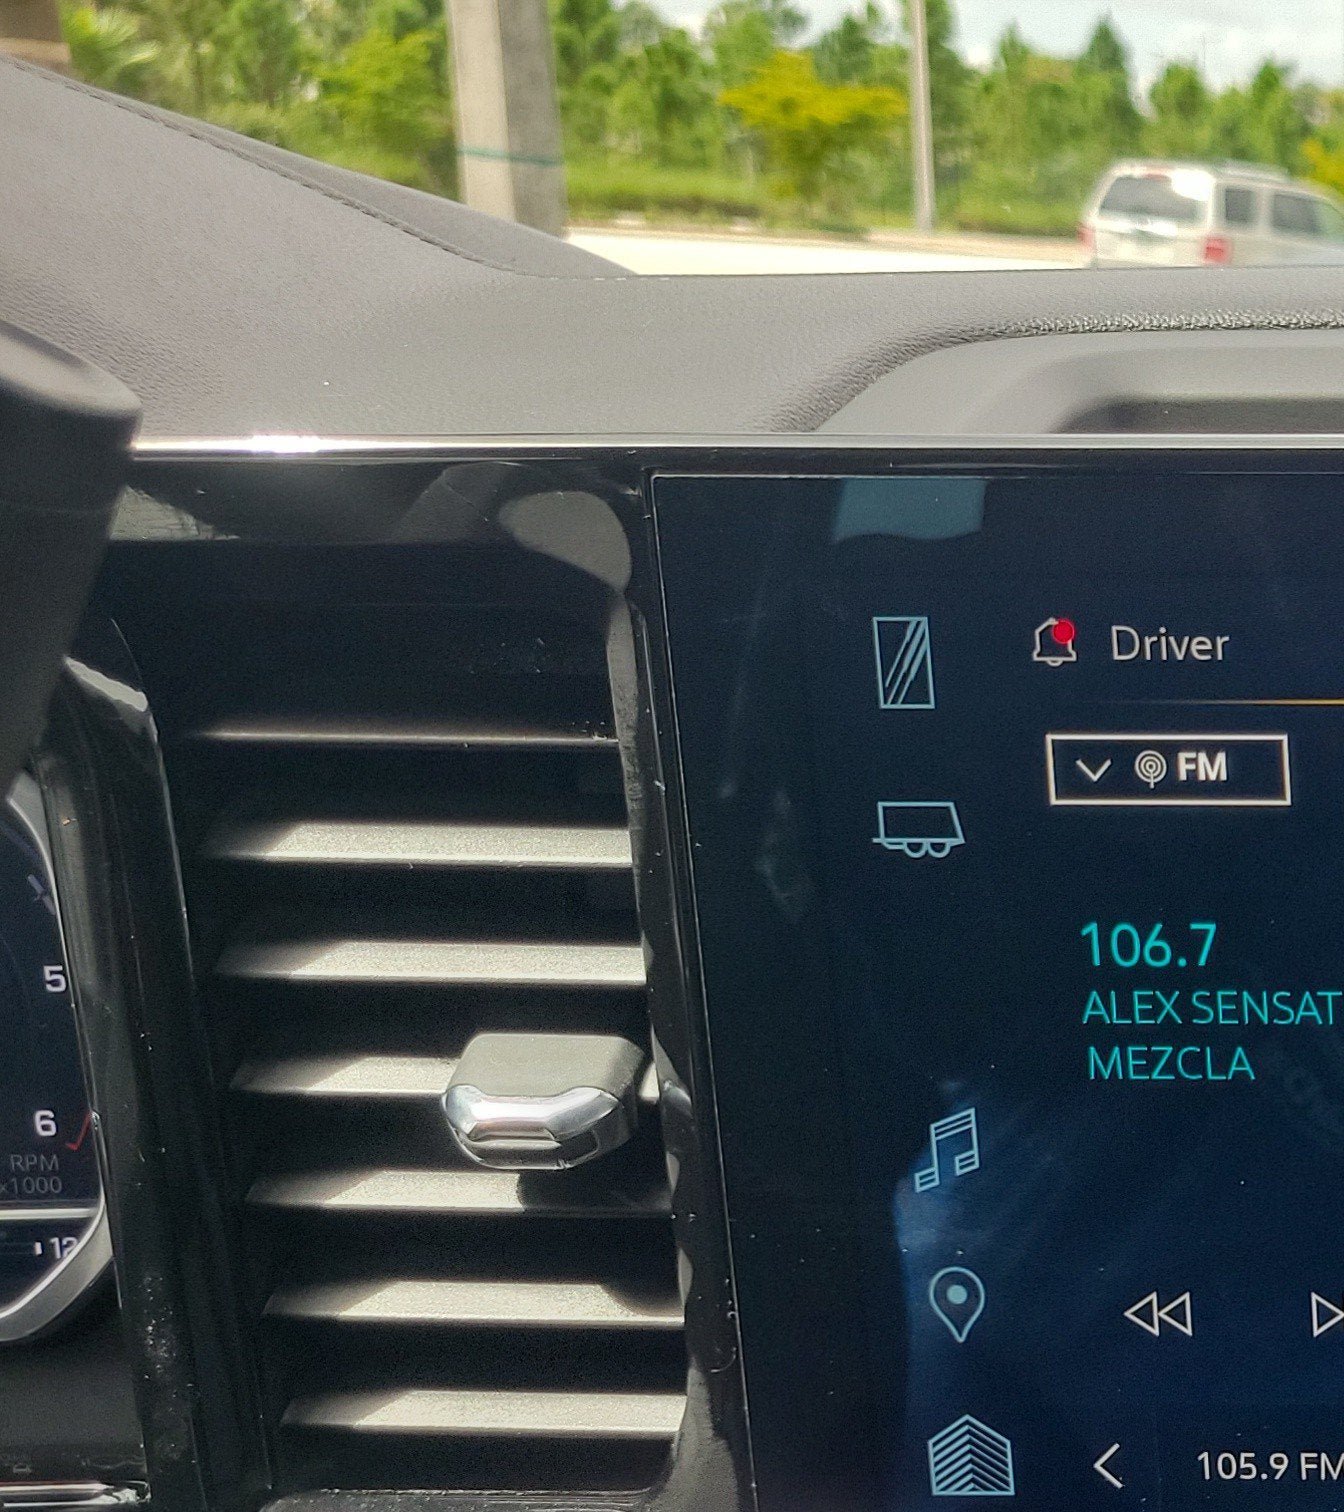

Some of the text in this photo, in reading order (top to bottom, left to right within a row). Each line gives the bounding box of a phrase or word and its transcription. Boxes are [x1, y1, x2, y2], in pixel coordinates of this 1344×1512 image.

[1111, 624, 1230, 661] Driver
[1177, 751, 1227, 781] FM
[1081, 921, 1217, 968] 106.7
[43, 965, 67, 992] 5
[1082, 989, 1183, 1026] ALEX
[1088, 1045, 1256, 1081] MEZCLA
[33, 1109, 57, 1137] 6
[9, 1153, 60, 1172] RPM
[1197, 1451, 1289, 1481] 105.9
